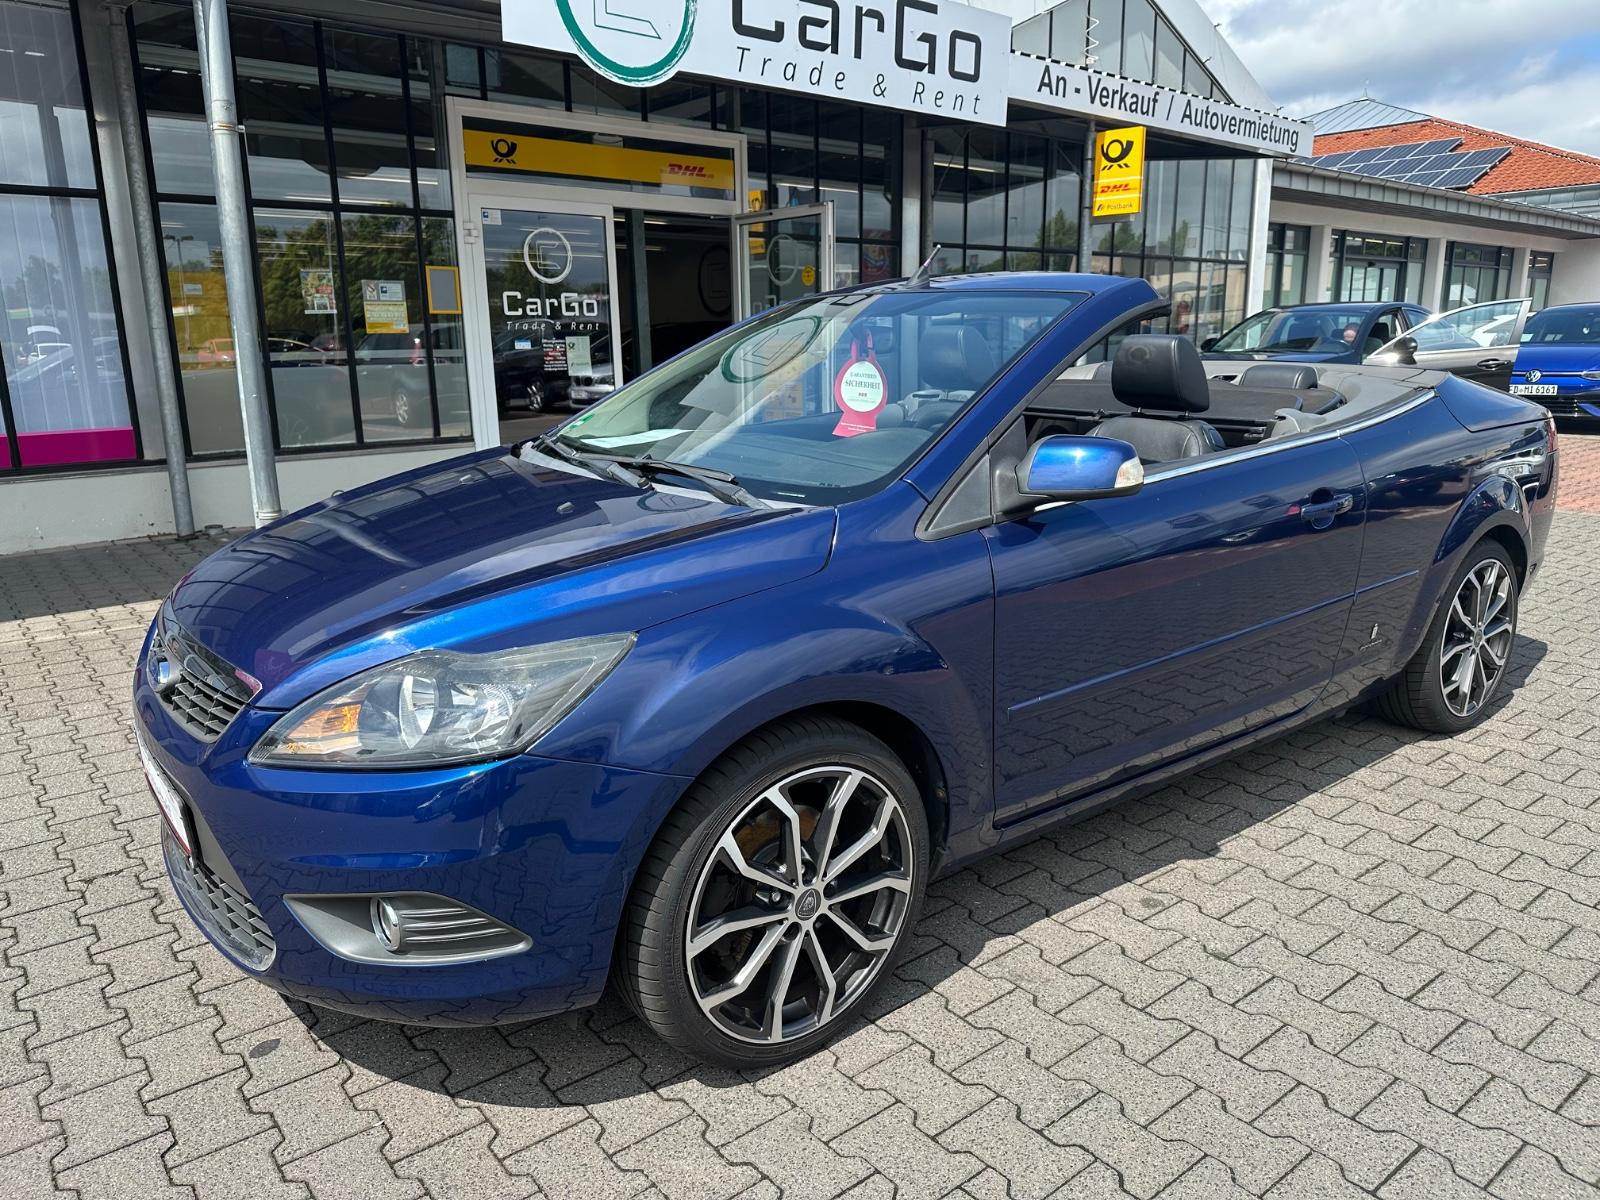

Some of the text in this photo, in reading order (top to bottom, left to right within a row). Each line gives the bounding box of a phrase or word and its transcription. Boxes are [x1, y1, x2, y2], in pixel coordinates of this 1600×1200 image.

[732, 0, 982, 83] CarGo
[737, 46, 981, 115] Trade & Rent
[1037, 64, 1067, 98] An
[1087, 75, 1160, 118] Verkauf
[1180, 99, 1299, 153] Autovermietung
[668, 163, 706, 178] DHL
[1100, 183, 1131, 194] DHL
[1106, 202, 1133, 211] Postbank
[502, 291, 598, 317] CarGo
[506, 321, 600, 331] Trade & Rent
